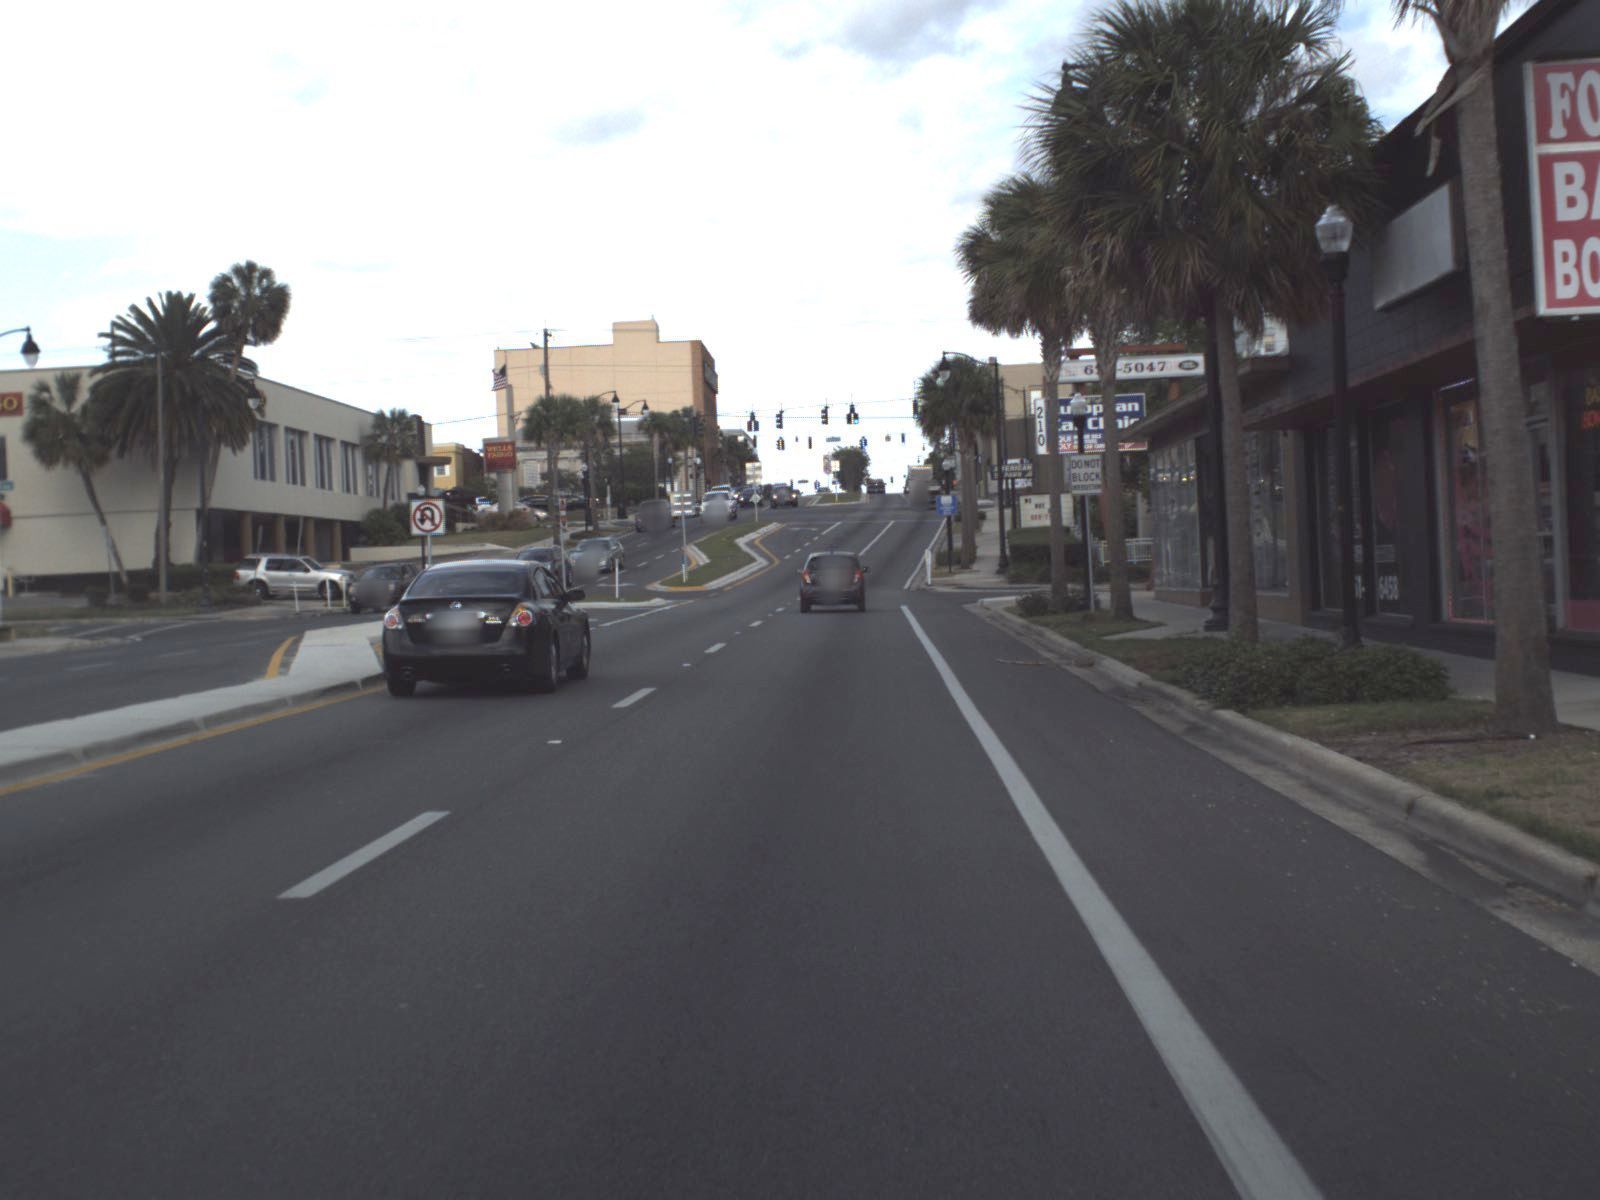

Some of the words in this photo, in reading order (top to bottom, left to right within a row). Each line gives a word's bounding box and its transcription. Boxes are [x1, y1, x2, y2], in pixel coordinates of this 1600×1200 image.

[1552, 160, 1600, 222] B
[1071, 459, 1083, 469] DO
[1084, 459, 1100, 468] NOT
[1071, 472, 1100, 482] BLOCK
